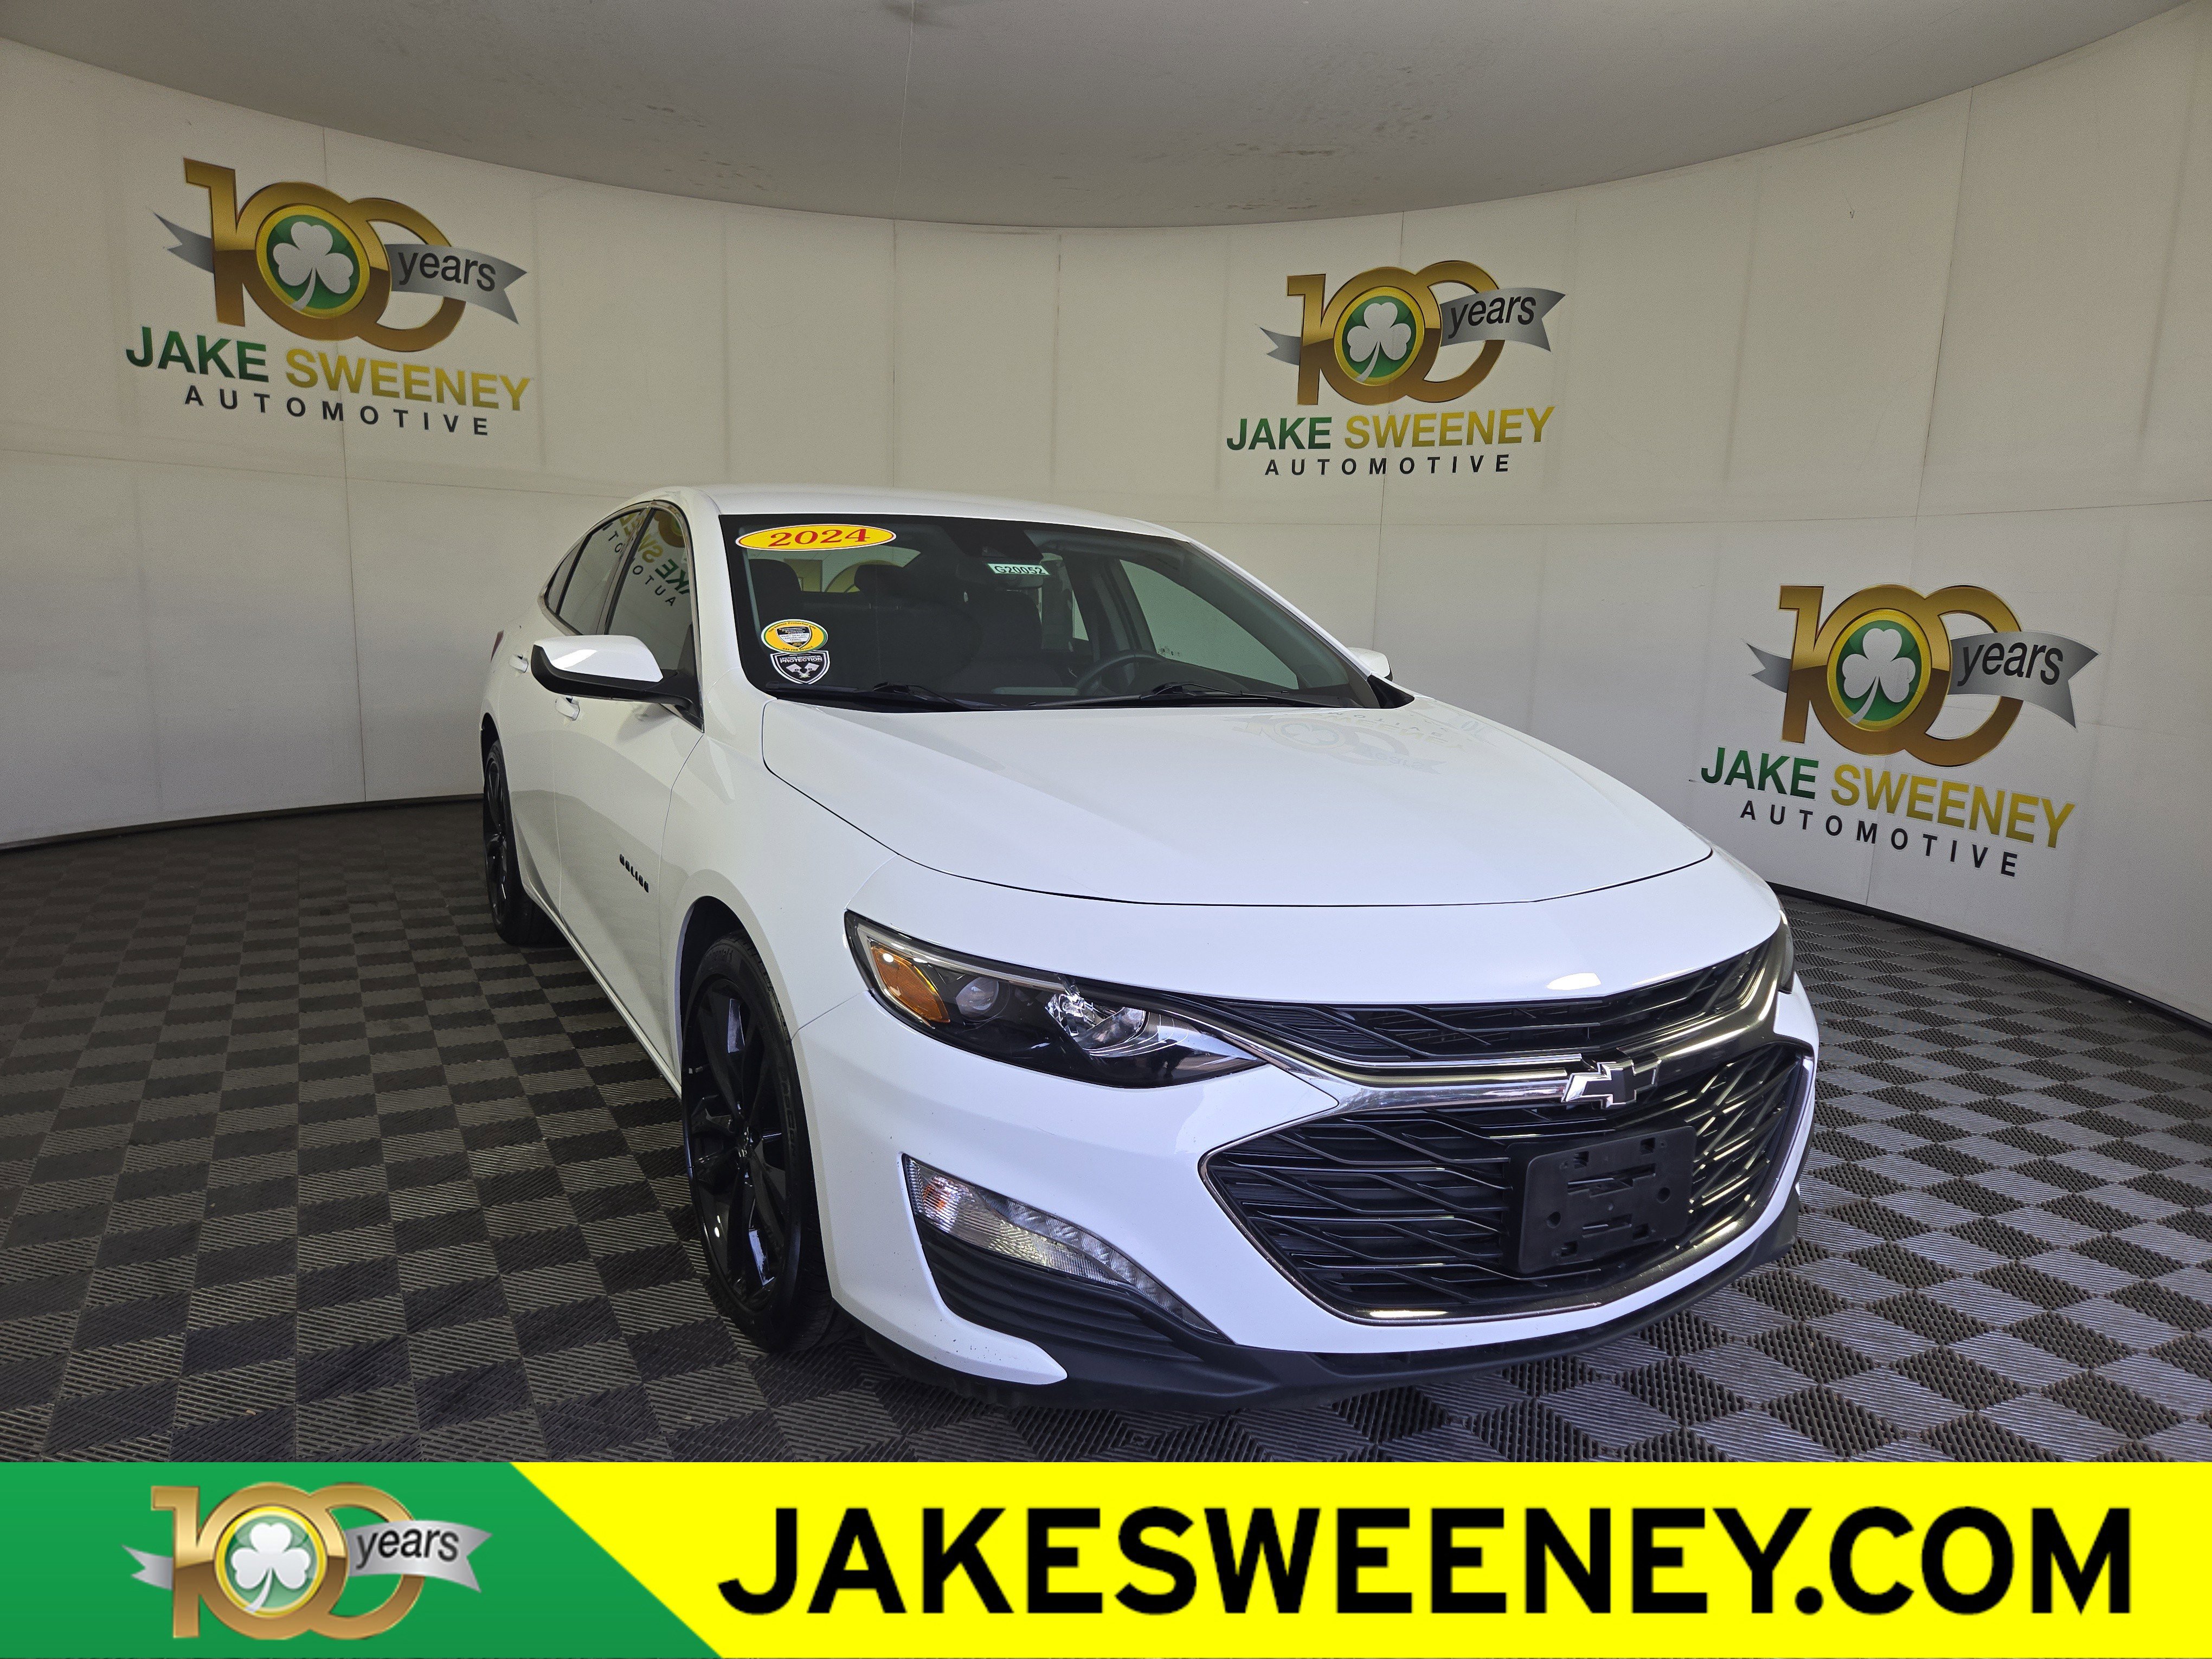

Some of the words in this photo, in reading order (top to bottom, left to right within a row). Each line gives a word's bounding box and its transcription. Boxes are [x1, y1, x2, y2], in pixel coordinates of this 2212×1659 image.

[183, 158, 466, 352] 100
[398, 252, 497, 291] years
[1287, 260, 1506, 406] 100
[1448, 295, 1536, 339] years
[126, 326, 269, 382] JAKE
[286, 349, 530, 411] SWEENEY
[184, 385, 488, 435] AUTOMOTIVE
[1227, 417, 1332, 451] JAKE
[1345, 407, 1555, 449] SWEENEY
[1265, 454, 1509, 475] AUTOMOTIVE
[768, 529, 870, 546] 2024
[994, 566, 1046, 575] G20052
[1779, 584, 2024, 767] 100
[1957, 642, 2063, 686] years
[1701, 747, 1819, 800] JAKE
[1831, 764, 2075, 849] SWEENEY
[1740, 800, 2018, 877] AUTOMOTIVE
